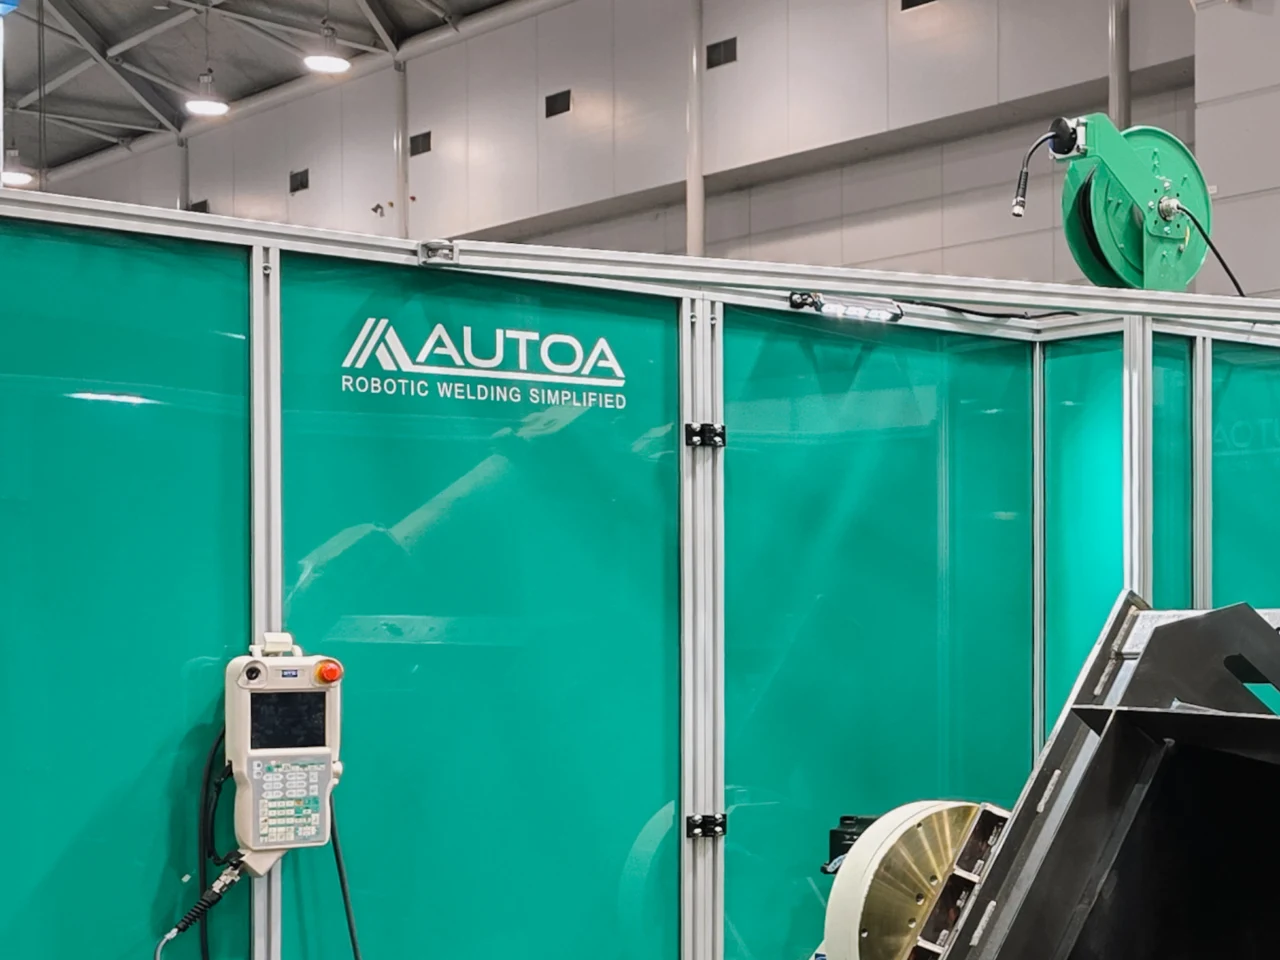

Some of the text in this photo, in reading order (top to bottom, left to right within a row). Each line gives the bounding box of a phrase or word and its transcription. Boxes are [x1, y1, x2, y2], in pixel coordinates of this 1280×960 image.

[415, 323, 626, 378] AUTOA
[341, 375, 627, 409] ROBOTIC WELDING SIMPLIFIED
